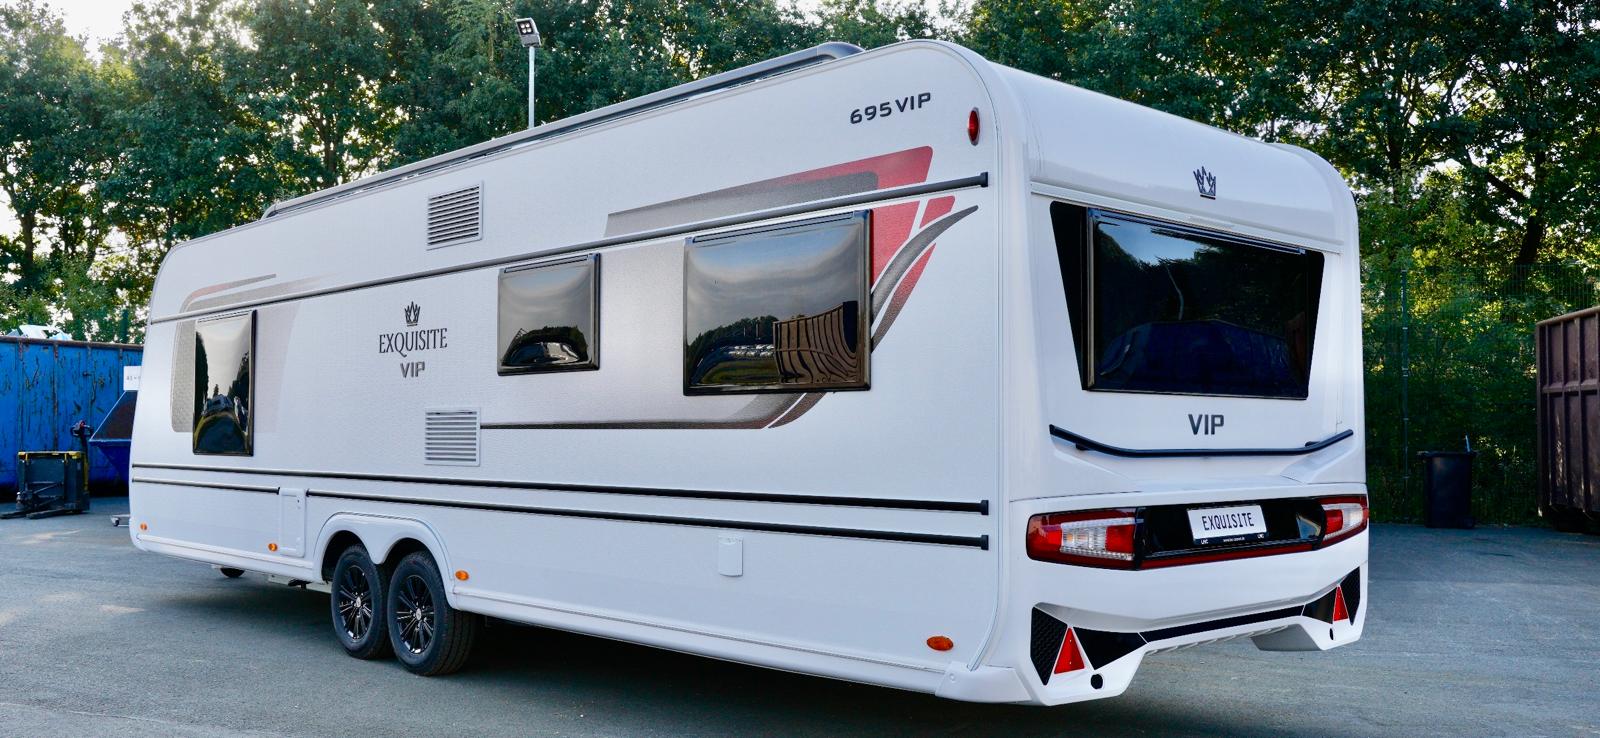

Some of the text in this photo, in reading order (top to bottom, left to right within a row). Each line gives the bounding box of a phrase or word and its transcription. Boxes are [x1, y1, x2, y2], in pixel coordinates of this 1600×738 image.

[379, 328, 448, 358] EXQUISITE
[400, 361, 425, 378] VIP
[1188, 414, 1224, 435] VIP
[1202, 512, 1254, 531] EXQUISITE
